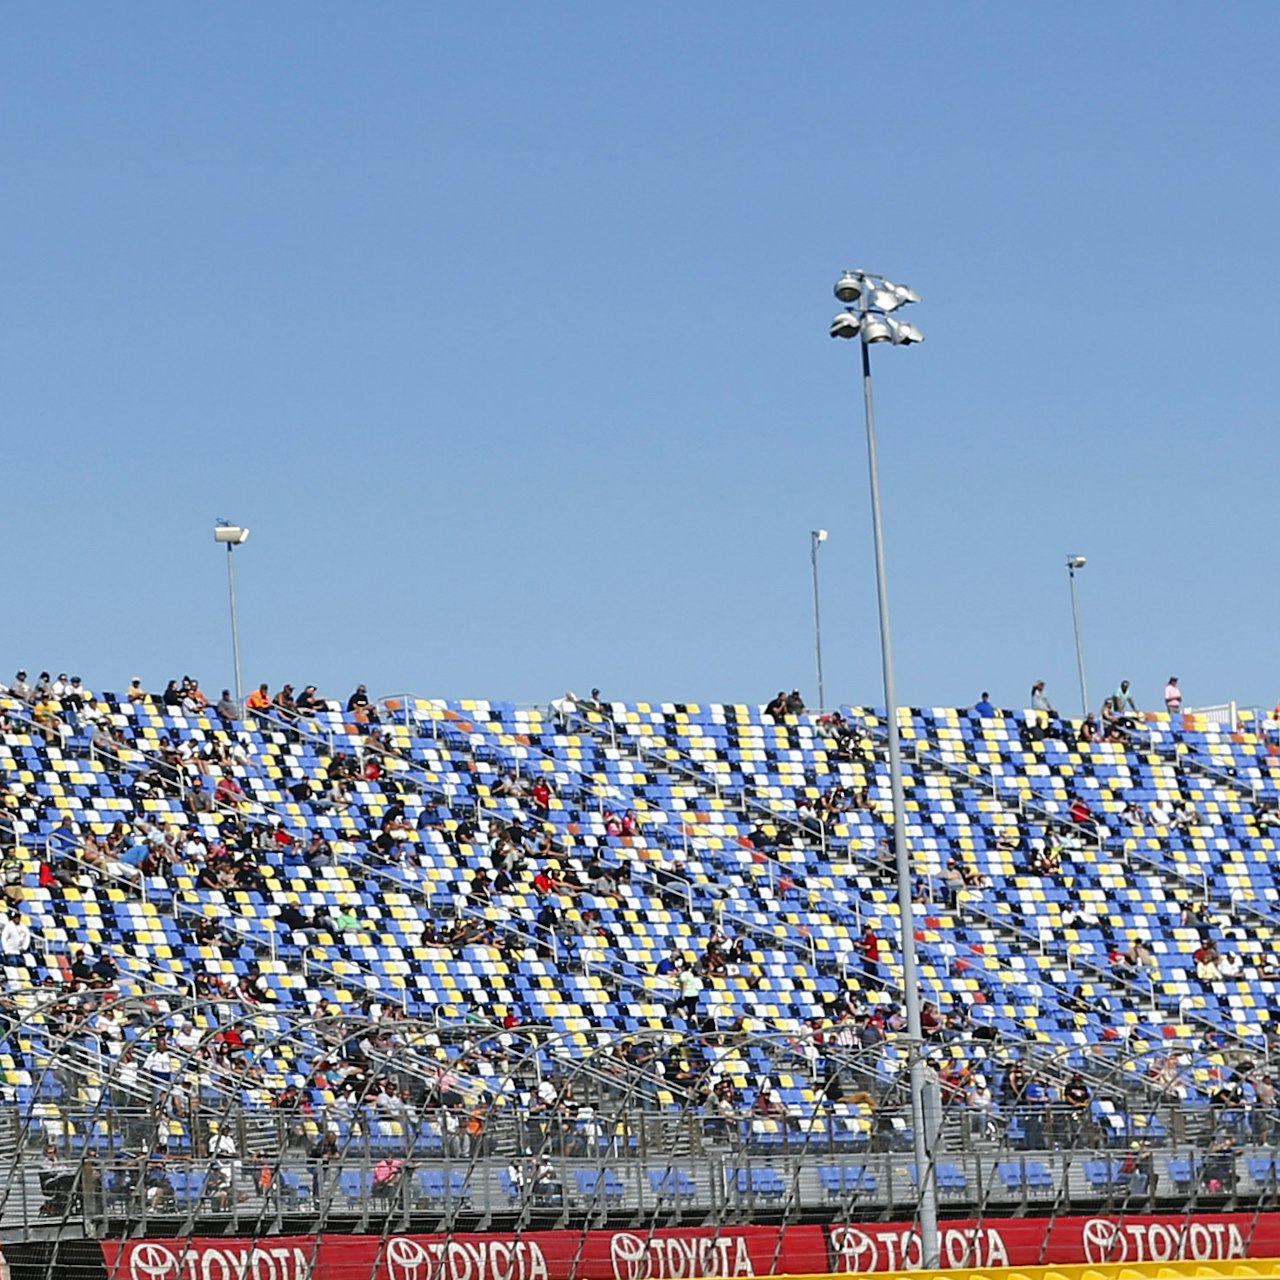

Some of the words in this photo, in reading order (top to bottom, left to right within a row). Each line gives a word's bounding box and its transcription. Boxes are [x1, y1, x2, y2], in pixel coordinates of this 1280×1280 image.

[650, 1237, 755, 1278] TOYOTA
[877, 1228, 1008, 1268] TOOTA
[1128, 1223, 1244, 1260] TOYOTA
